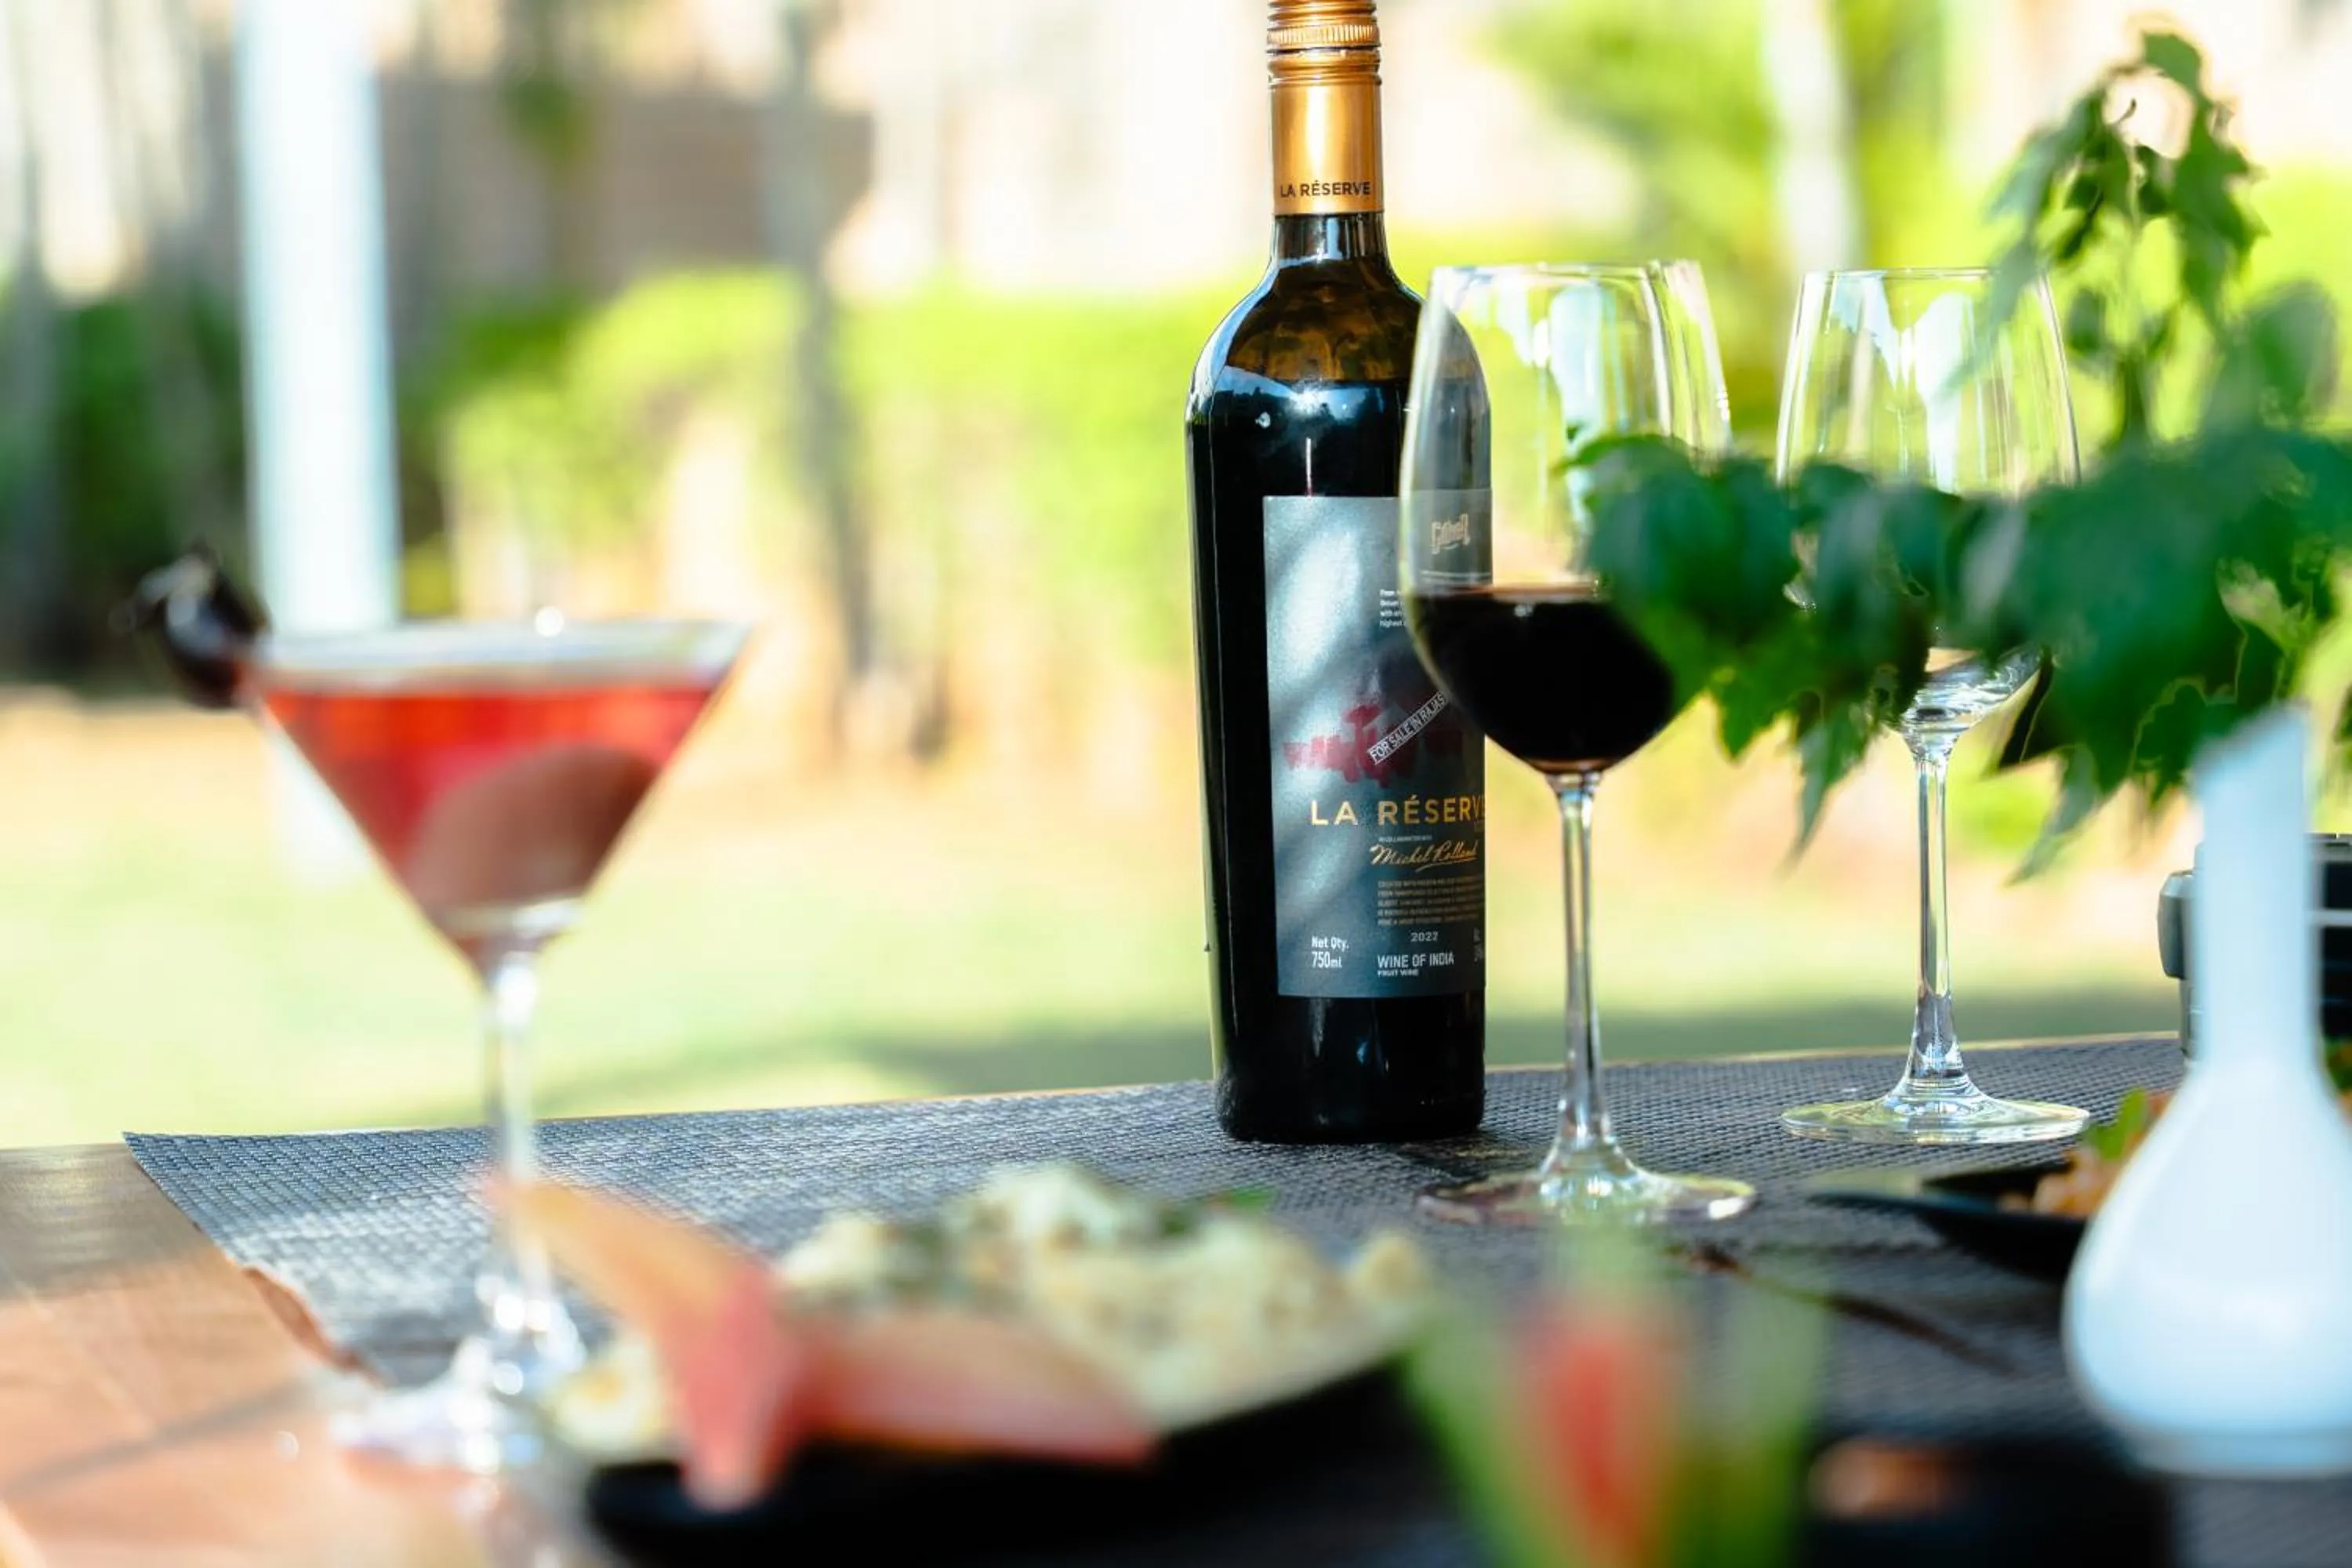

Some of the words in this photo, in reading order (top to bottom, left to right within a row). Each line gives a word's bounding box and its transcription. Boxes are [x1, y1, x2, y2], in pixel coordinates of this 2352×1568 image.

[1280, 184, 1296, 198] LA
[1300, 180, 1371, 196] RÉSERVE
[1369, 739, 1392, 762] FOR
[1387, 722, 1414, 747] SALE
[1311, 800, 1359, 826] LA
[1312, 935, 1329, 948] Net
[1330, 936, 1349, 953] Qty.
[1410, 931, 1439, 942] 2022
[1312, 951, 1343, 969] 750ml
[1377, 954, 1409, 969] WINE
[1412, 953, 1427, 967] OF
[1429, 951, 1455, 967] INDIA
